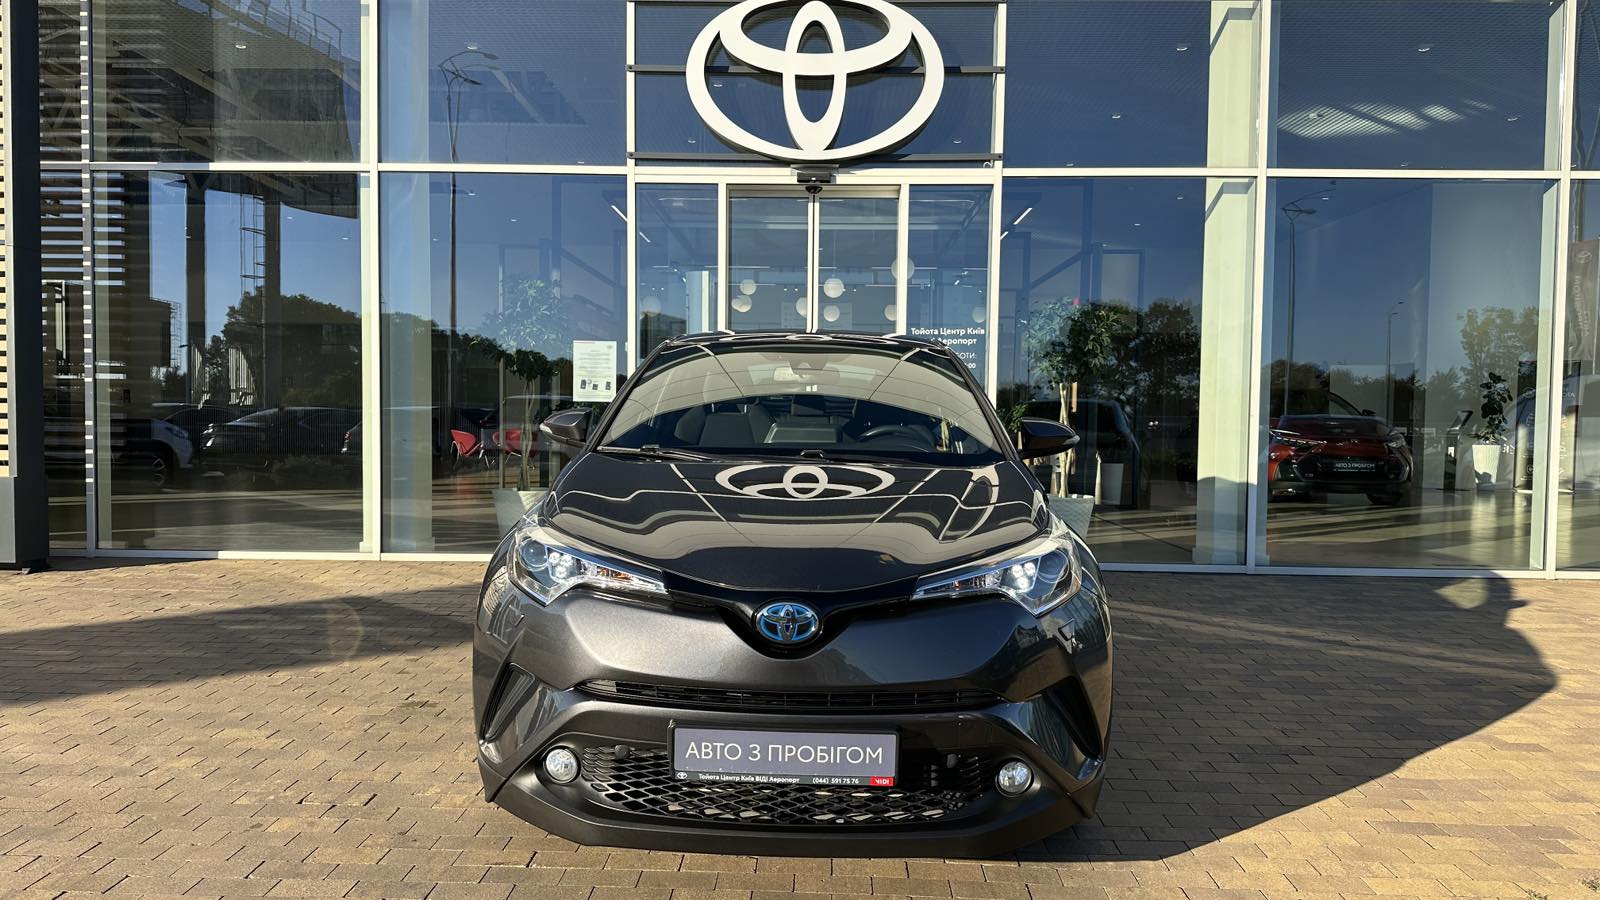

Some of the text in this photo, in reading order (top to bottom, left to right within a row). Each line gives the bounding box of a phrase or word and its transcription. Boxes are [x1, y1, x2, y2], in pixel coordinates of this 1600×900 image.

[940, 328, 966, 336] Центр
[685, 741, 883, 764] АВТО З ПРОБІГОМ
[720, 774, 740, 782] Центр
[769, 776, 800, 784] Аеропорт
[812, 777, 829, 785] (044)
